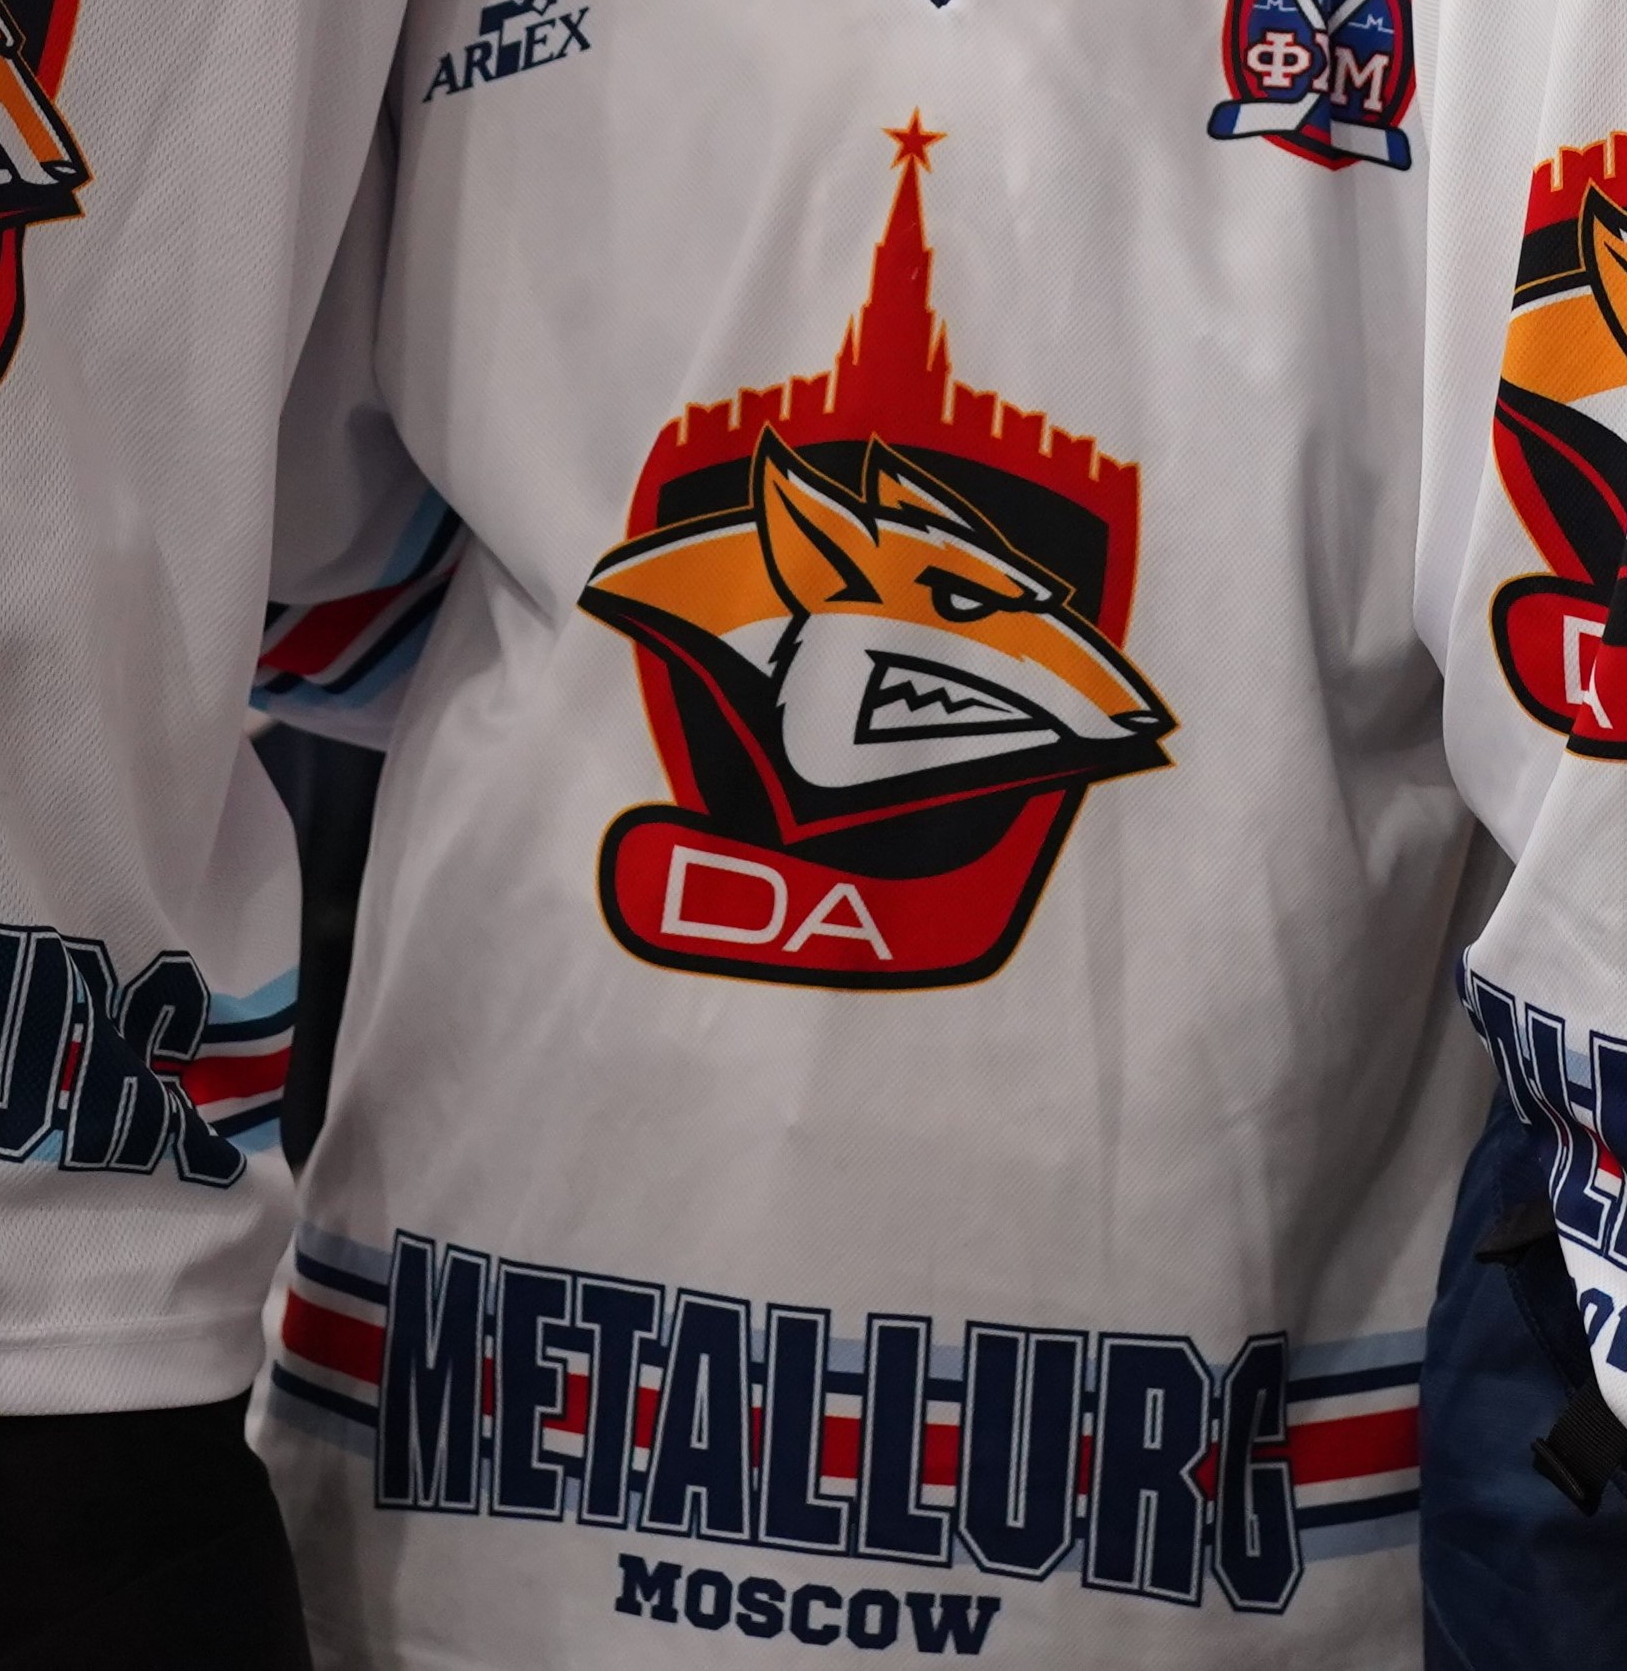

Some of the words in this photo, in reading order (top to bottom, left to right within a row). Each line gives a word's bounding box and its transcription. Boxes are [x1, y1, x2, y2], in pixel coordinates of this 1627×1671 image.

[660, 844, 894, 961] DA
[375, 1227, 1305, 1616] METALLURG
[615, 1551, 1002, 1657] MOSCOW
